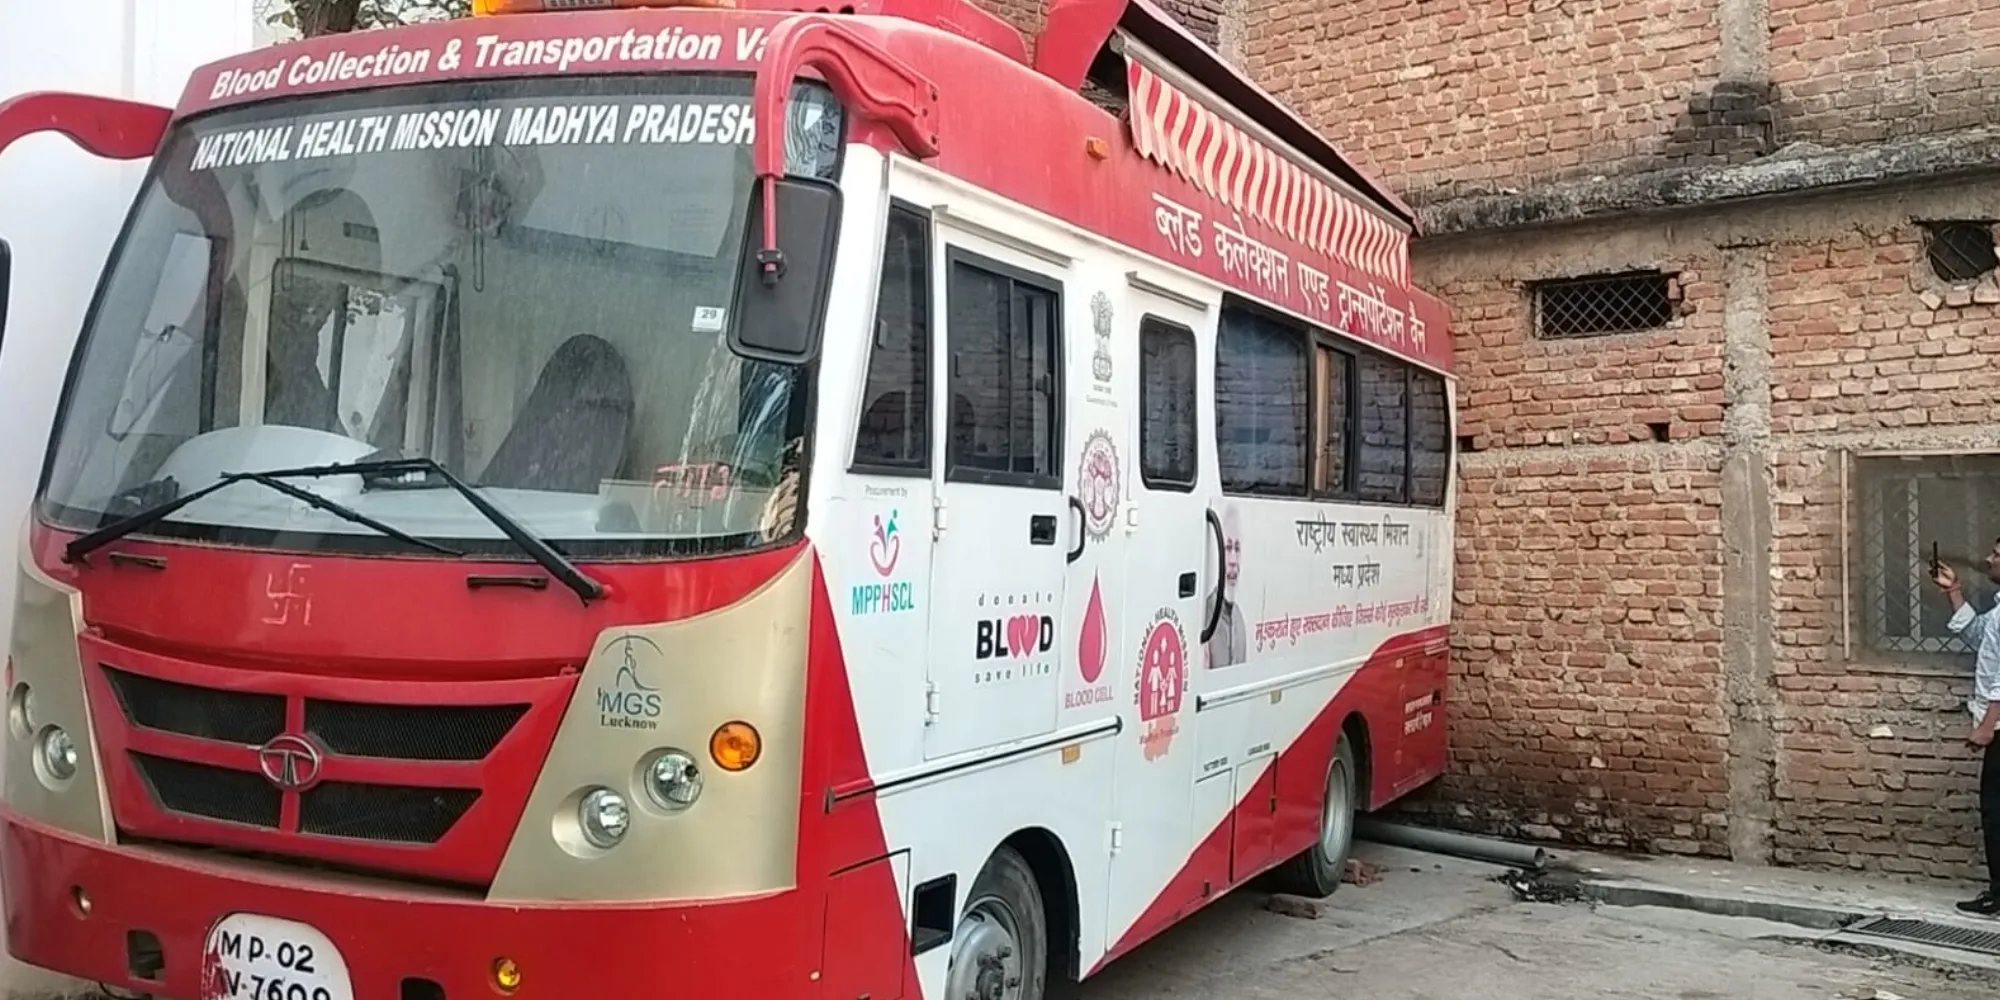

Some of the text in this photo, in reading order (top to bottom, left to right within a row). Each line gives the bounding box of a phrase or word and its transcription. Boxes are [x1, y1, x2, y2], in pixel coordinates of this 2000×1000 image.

[209, 26, 768, 100] Blood Collection & Transportation Va
[190, 104, 756, 172] NATIONAL HEALTH MISSION MADHYA PRADESH
[1152, 191, 1203, 257] ब्लड
[1212, 212, 1289, 299] कलेक्शन
[1297, 261, 1330, 312] एण्ड
[1295, 509, 1337, 555] राष्ट्रीय
[1382, 512, 1410, 546] मिशन
[1333, 554, 1381, 589] मध्य प्रदेश
[852, 581, 915, 616] MPPHSCL
[975, 662, 1050, 684] save life
[1064, 685, 1114, 709] BLOOD CELL
[601, 714, 658, 731] Lucknow
